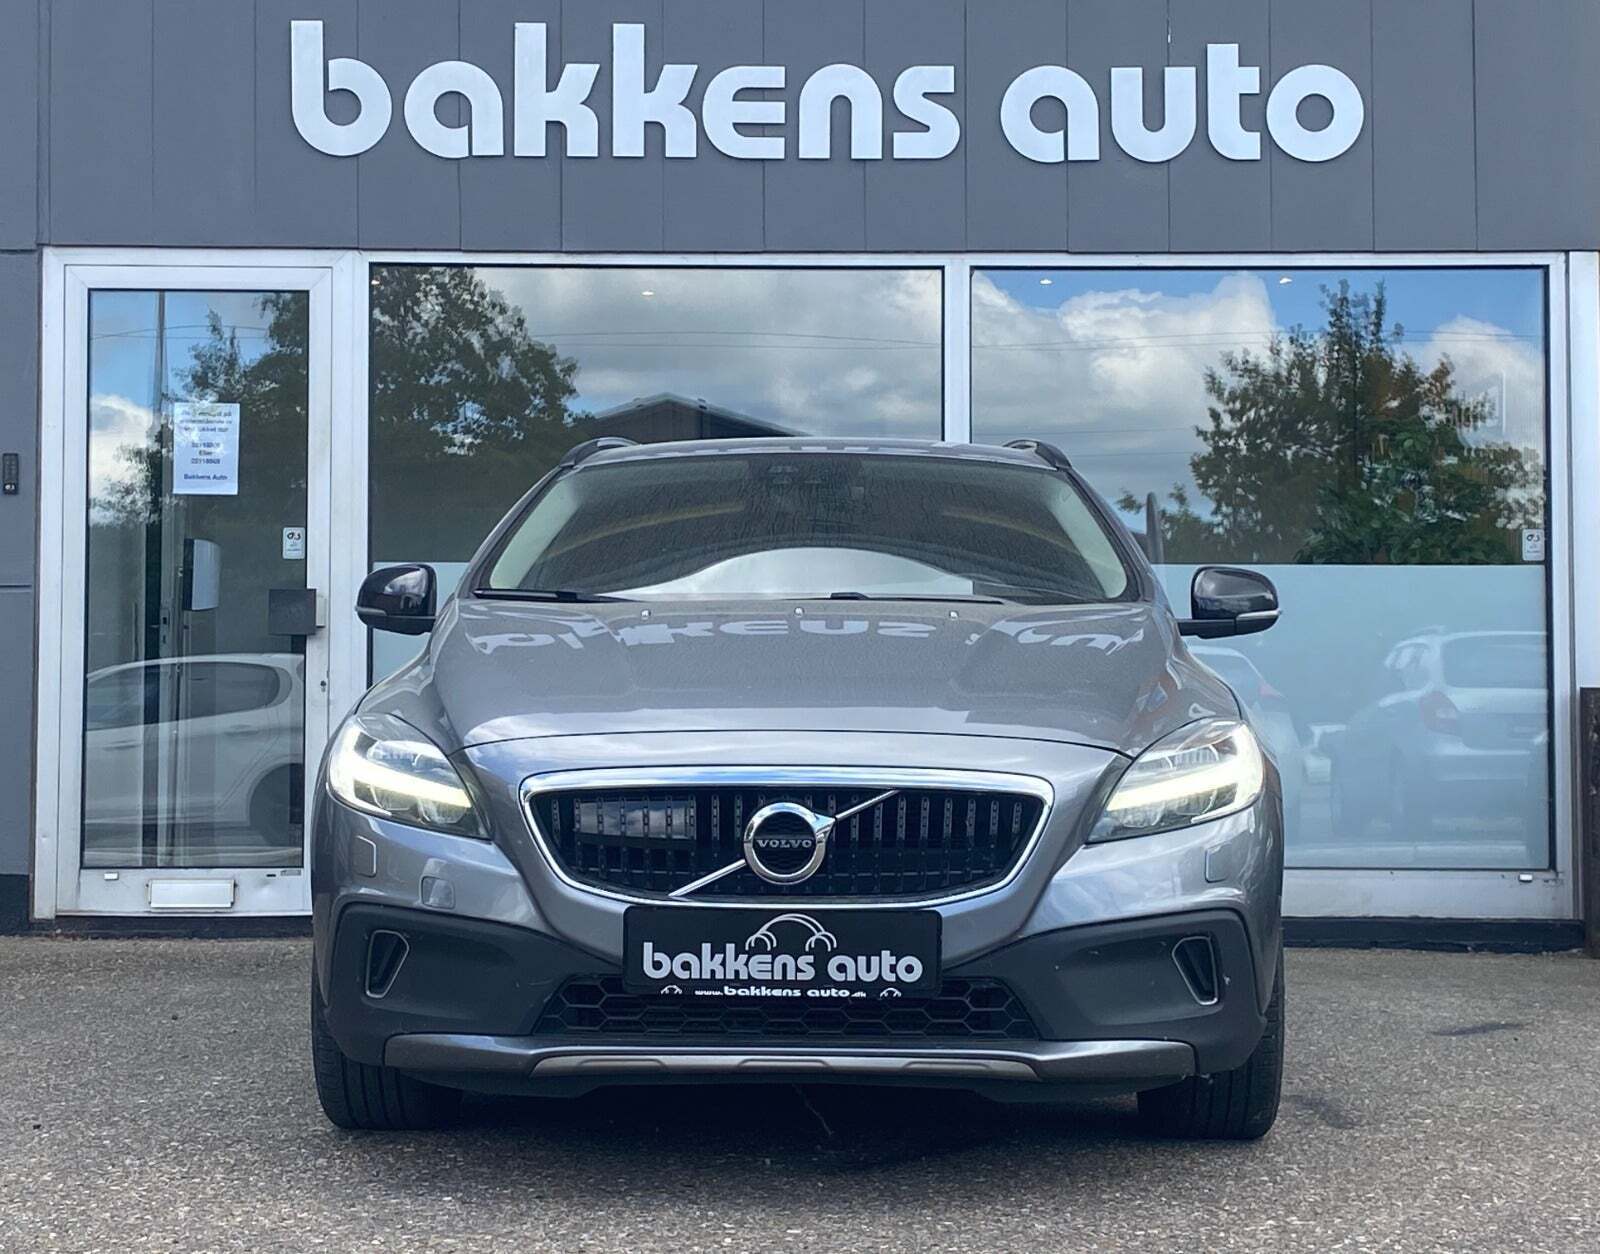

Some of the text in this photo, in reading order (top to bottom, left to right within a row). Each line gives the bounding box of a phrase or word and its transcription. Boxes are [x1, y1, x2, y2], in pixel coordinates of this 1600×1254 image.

[291, 20, 1365, 163] bakkens auto
[757, 839, 812, 848] VOLVO
[643, 942, 923, 983] bakkens auto
